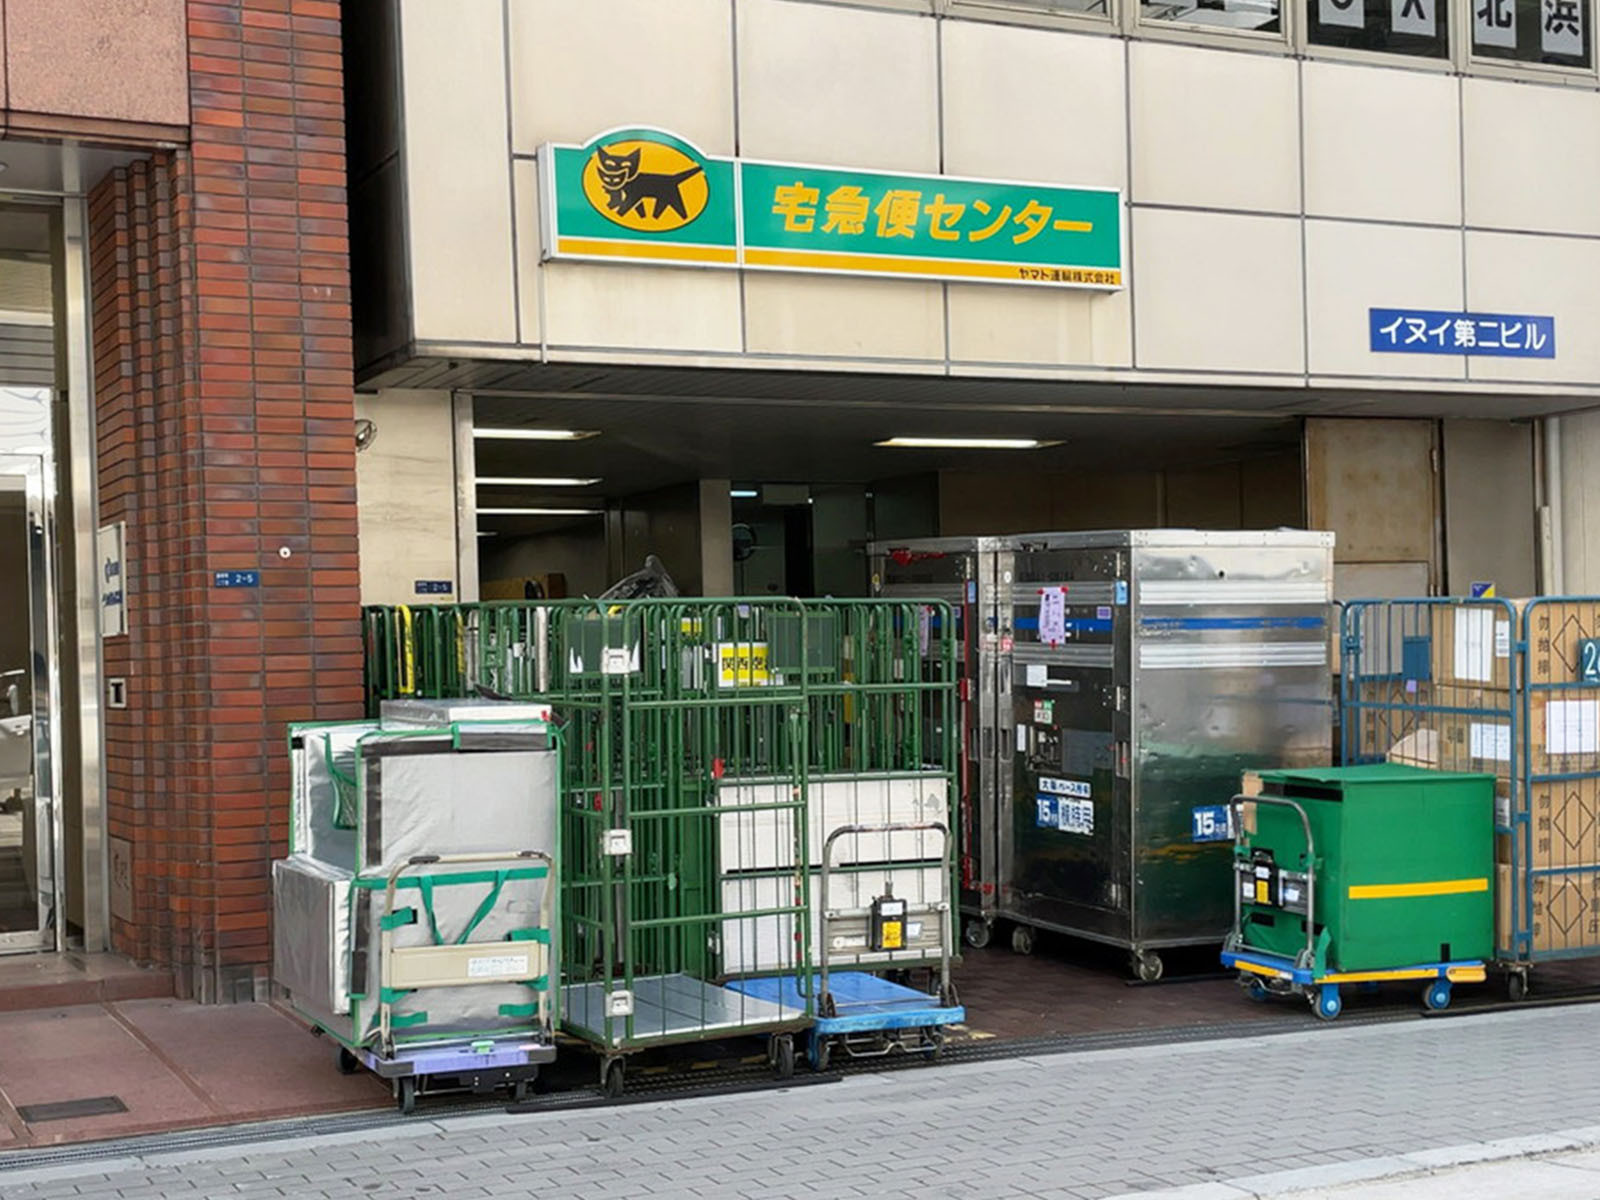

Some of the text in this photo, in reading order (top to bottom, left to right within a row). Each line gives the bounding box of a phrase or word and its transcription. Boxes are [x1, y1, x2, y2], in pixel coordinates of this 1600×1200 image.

[772, 181, 1093, 245] 宅急便センター
[1019, 268, 1115, 285] ヤマト運輸株式会社
[1380, 317, 1546, 350] イヌイ第二ビル
[235, 574, 253, 584] 2-5
[722, 656, 769, 671] 関西空
[1584, 641, 1600, 675] 2
[1194, 811, 1215, 835] 15
